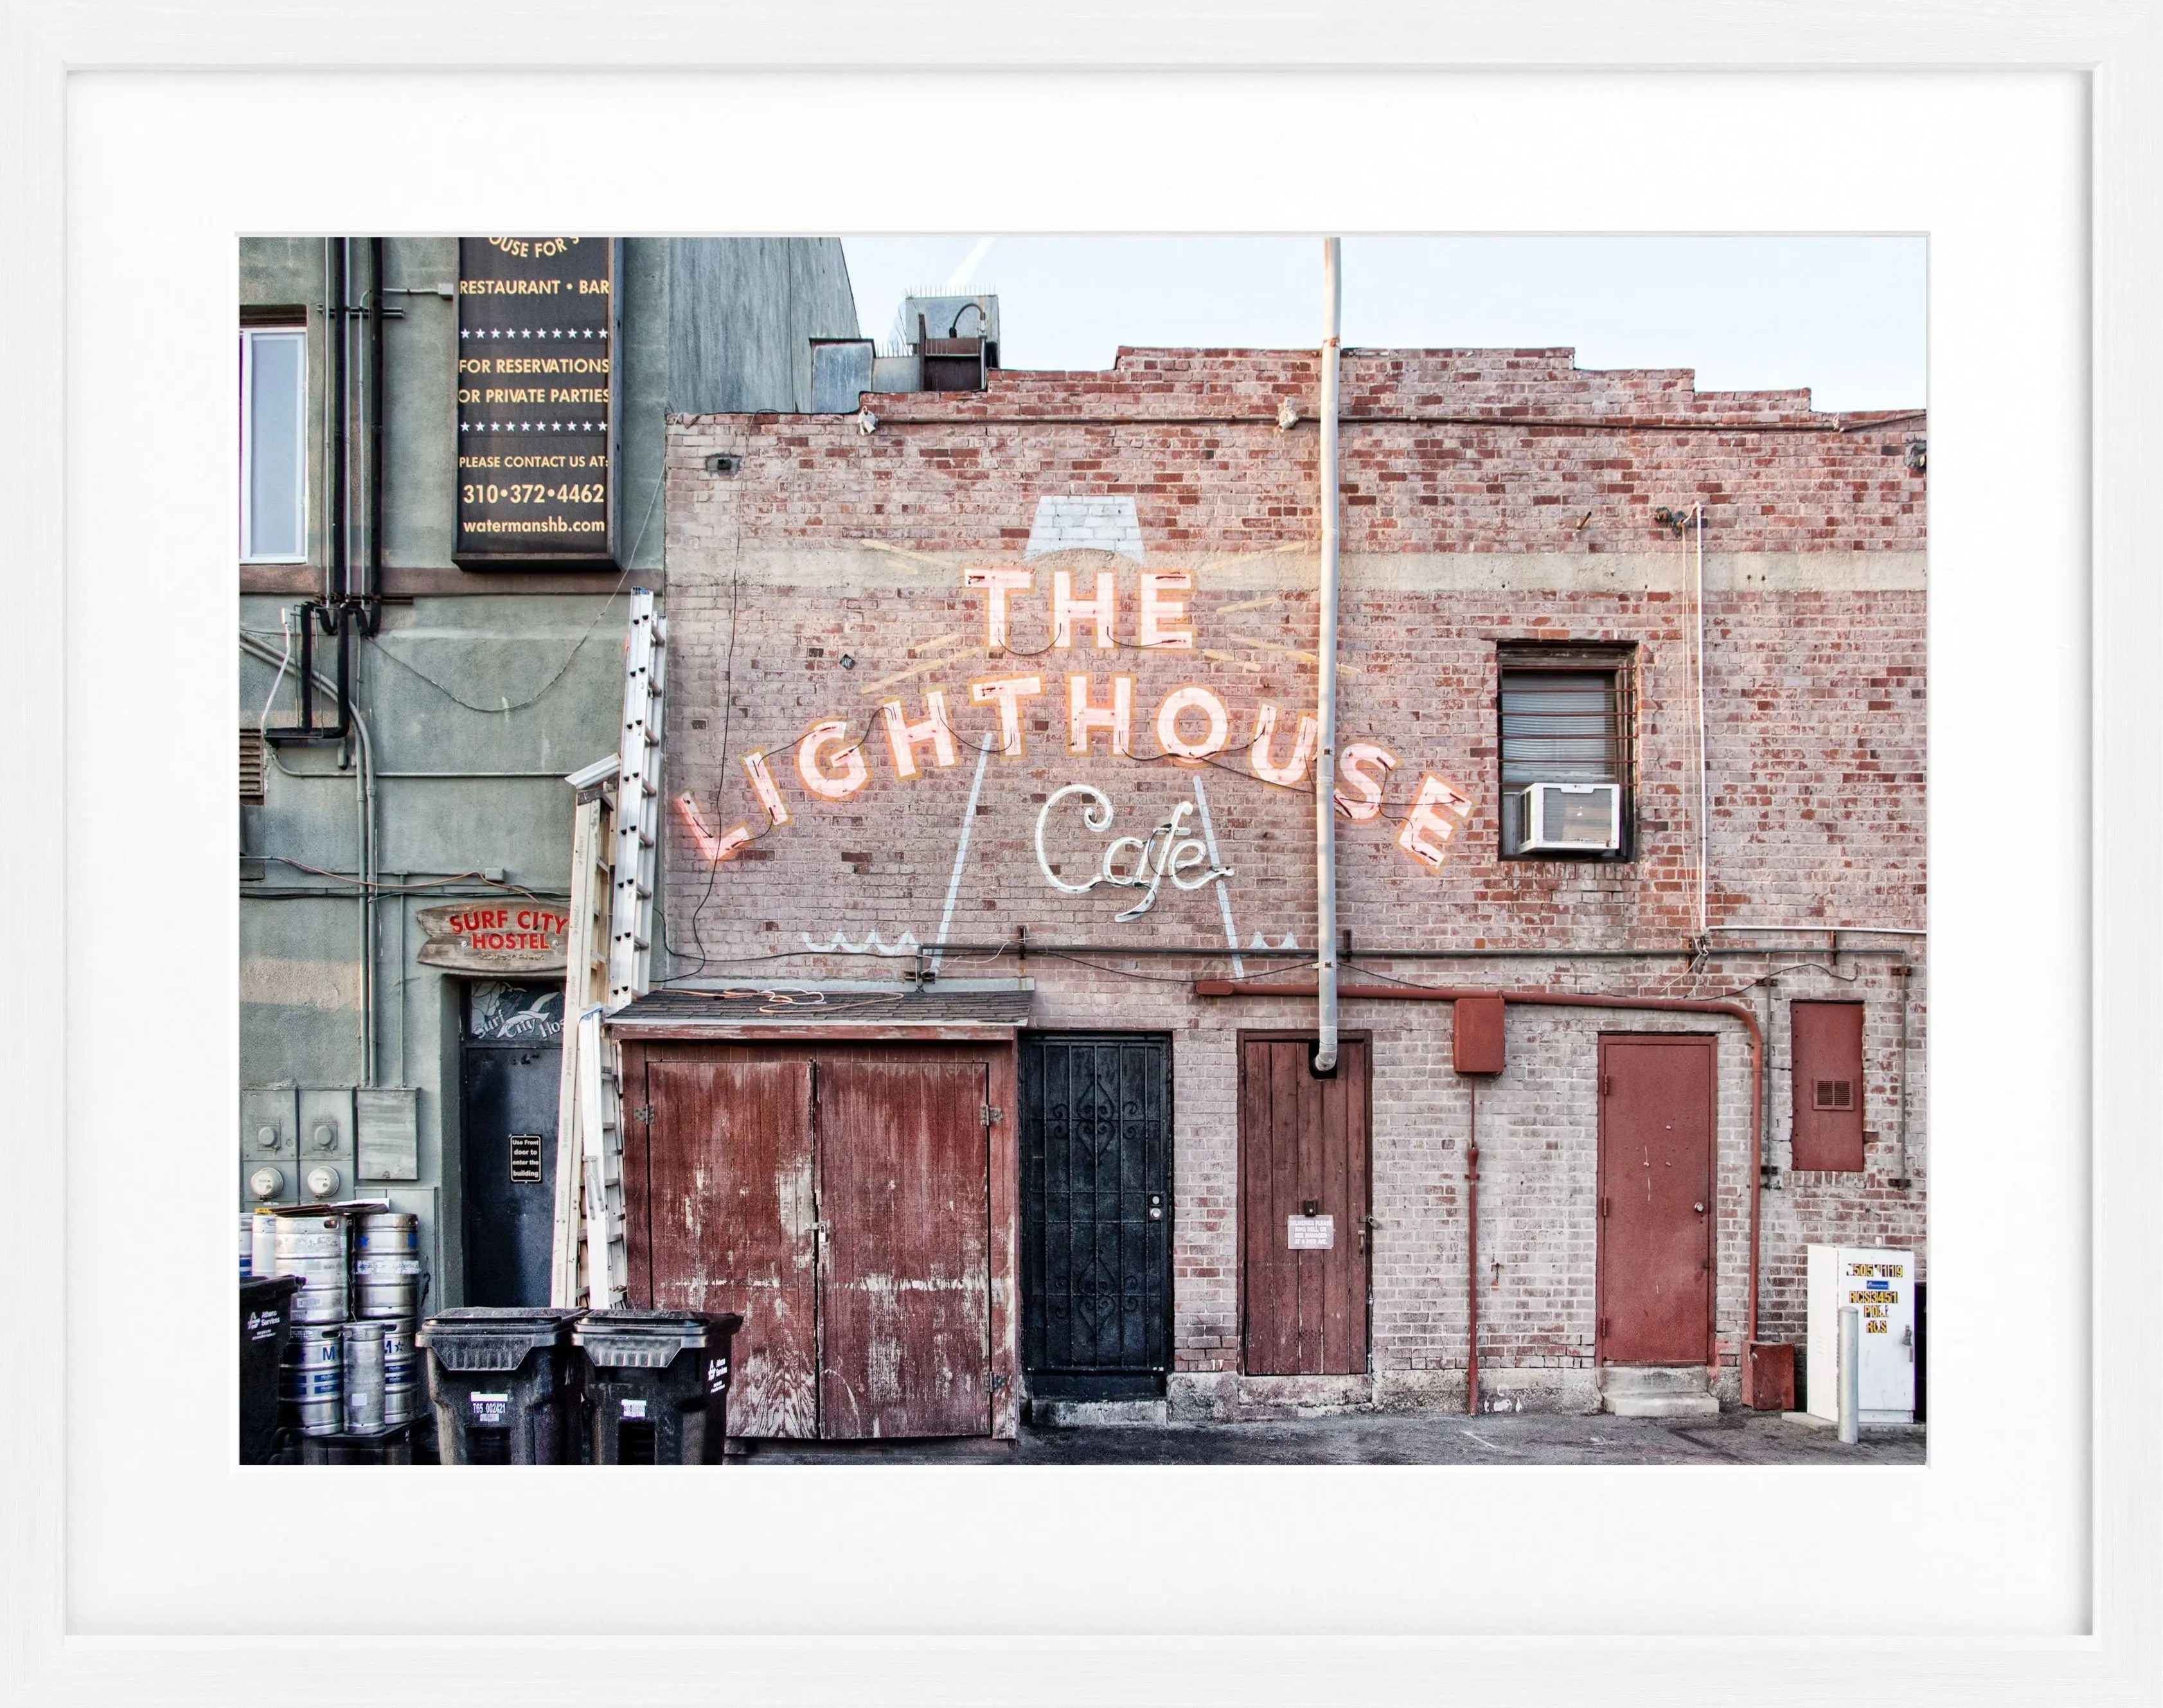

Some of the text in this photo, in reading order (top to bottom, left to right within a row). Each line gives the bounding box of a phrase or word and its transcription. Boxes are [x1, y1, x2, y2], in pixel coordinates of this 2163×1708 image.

[535, 238, 567, 258] FOR
[459, 280, 609, 294] RESTAURANT BAR
[459, 359, 609, 373] FOR RESERVATIONS
[459, 389, 609, 403] OR PRIVATE PARTIES
[459, 456, 609, 468] PLEASE CONTACT US AT:
[463, 516, 605, 532] watermanshb.com
[963, 567, 1195, 650] THE
[676, 672, 1475, 875] LIGHTHOUSE
[450, 910, 569, 936] SURF CITY
[472, 933, 549, 950] HOSTEL
[474, 1009, 504, 1039] Surf
[505, 1018, 537, 1038] City
[1849, 1291, 1898, 1303] RCS3451
[261, 1317, 280, 1326] Services
[323, 1346, 335, 1361] M
